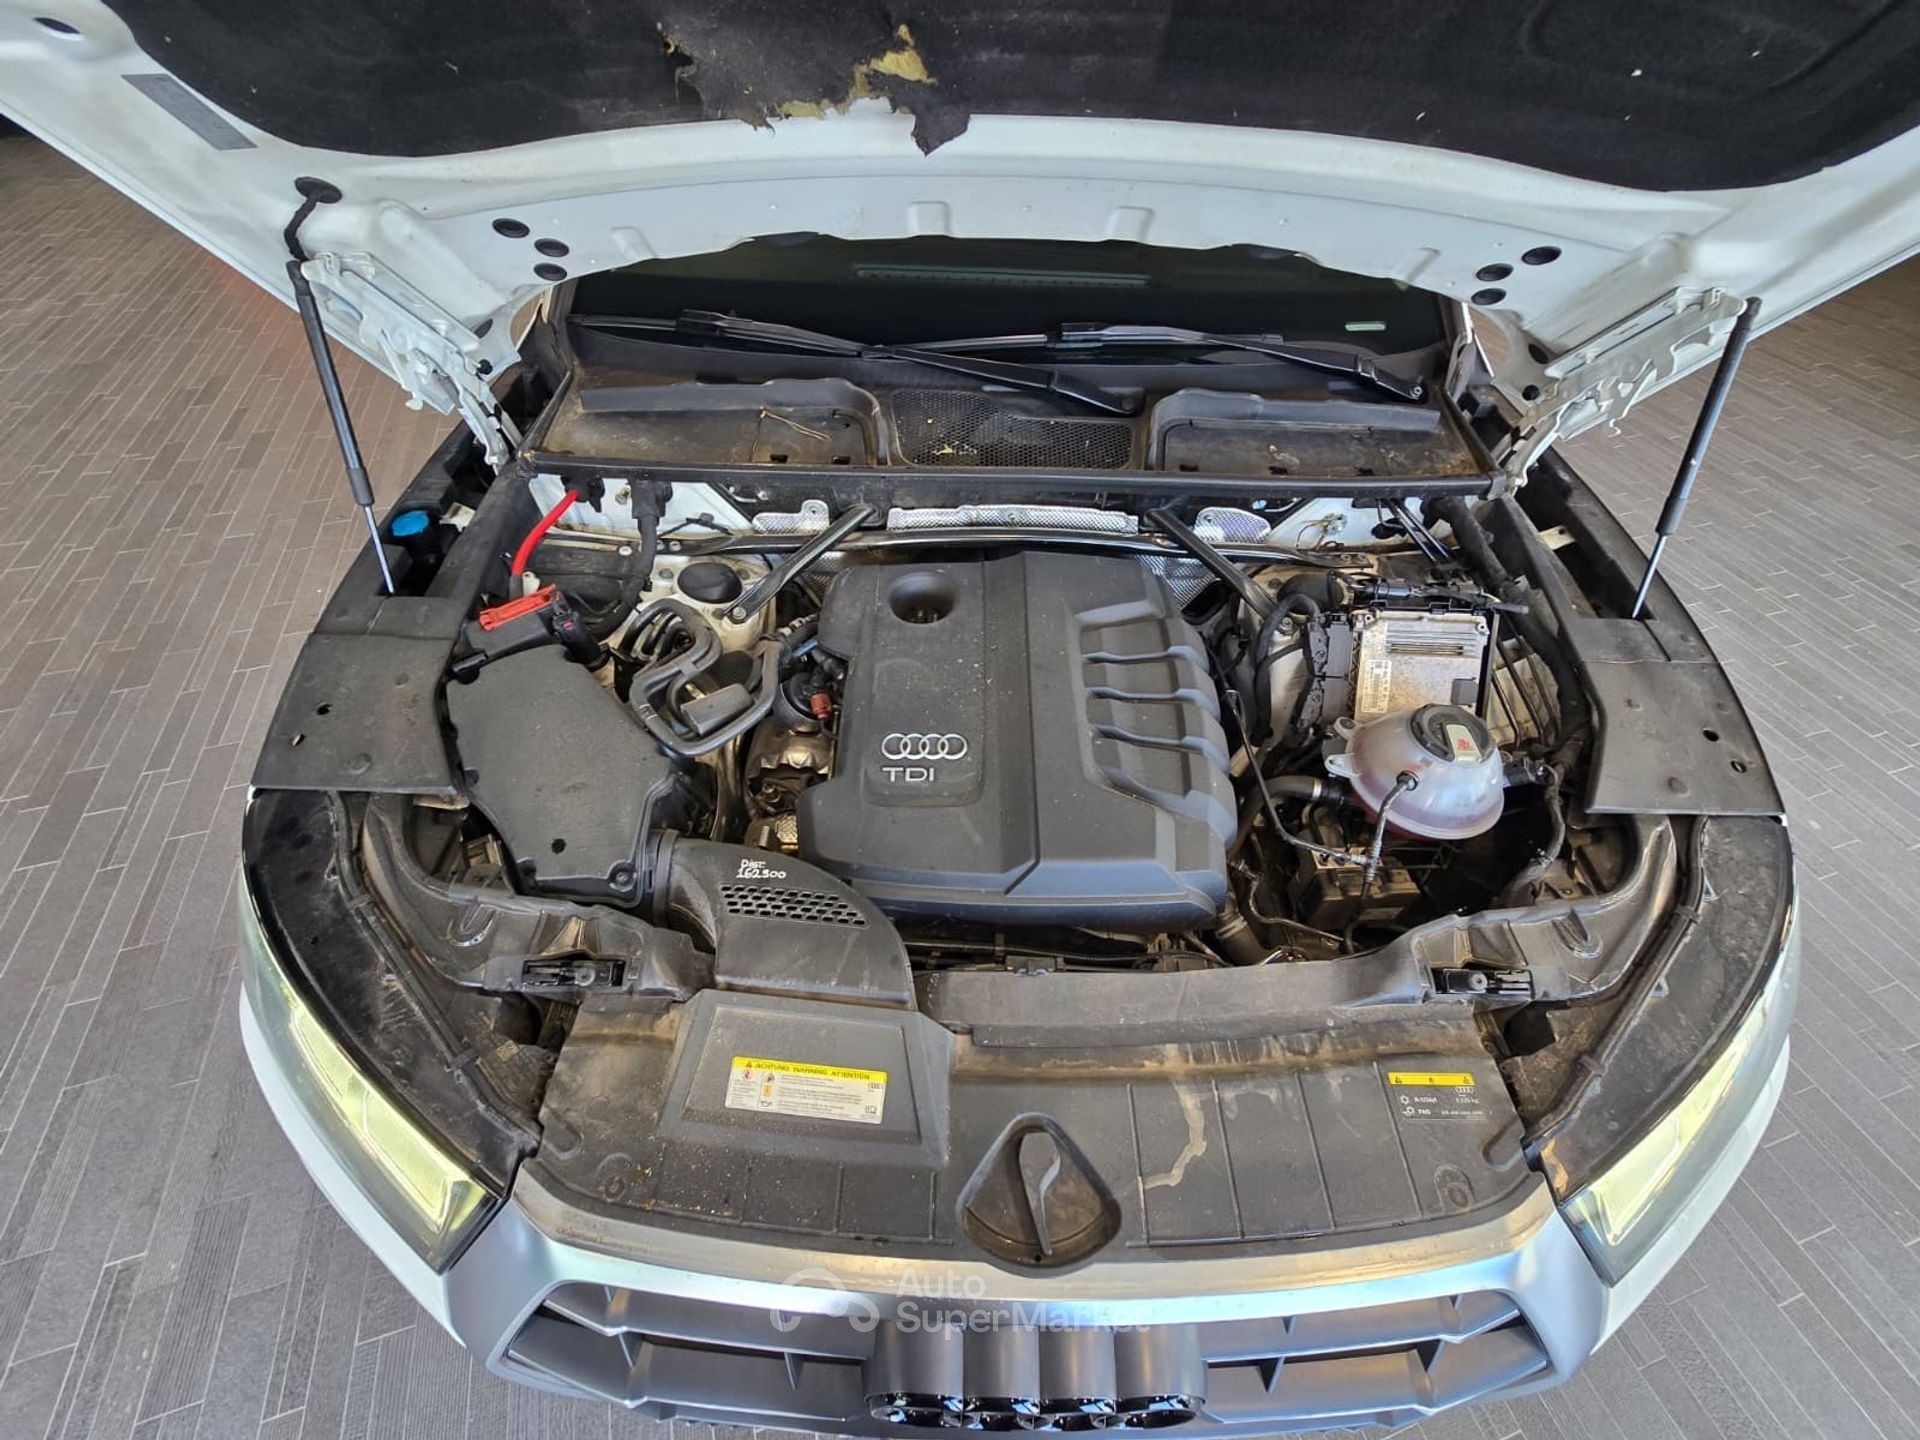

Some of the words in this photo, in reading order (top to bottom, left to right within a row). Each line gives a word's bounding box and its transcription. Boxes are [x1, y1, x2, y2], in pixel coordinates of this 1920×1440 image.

[882, 767, 934, 782] TDI
[793, 1066, 828, 1076] WARNING
[831, 1070, 870, 1081] ATTENTION
